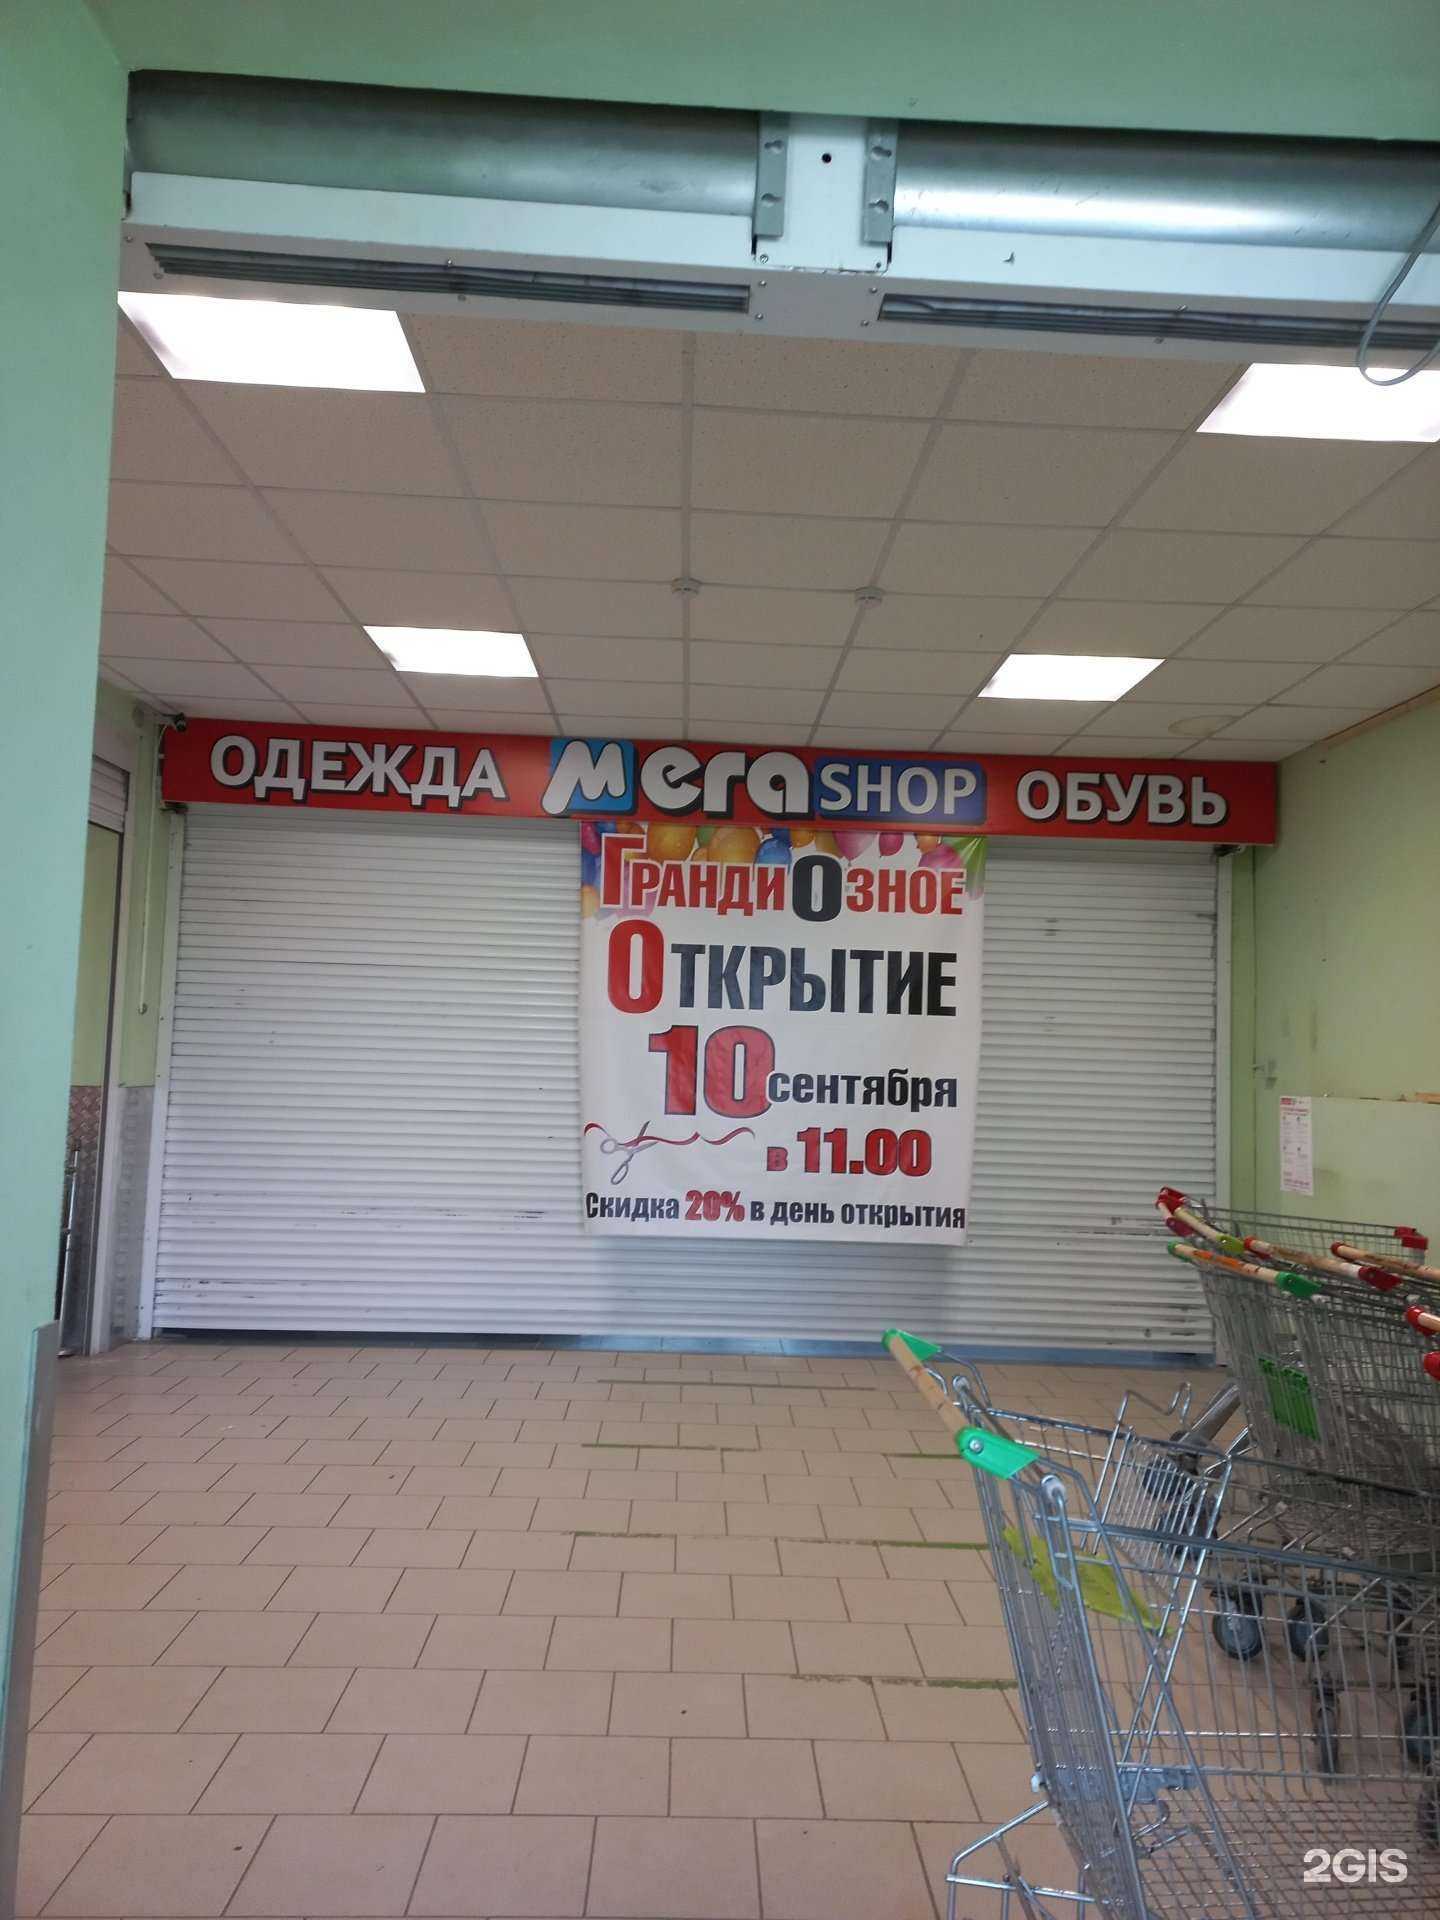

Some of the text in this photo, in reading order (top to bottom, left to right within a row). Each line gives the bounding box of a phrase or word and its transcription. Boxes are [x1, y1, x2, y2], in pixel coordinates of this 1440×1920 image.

[210, 735, 508, 808] ОДЕЖДА
[820, 763, 978, 815] SHOP
[1017, 769, 1228, 825] ОБУВЬ
[648, 1024, 959, 1119] 10 сентября
[766, 1126, 933, 1177] в 11.00
[586, 1189, 966, 1229] Скидка 20% в день открытия
